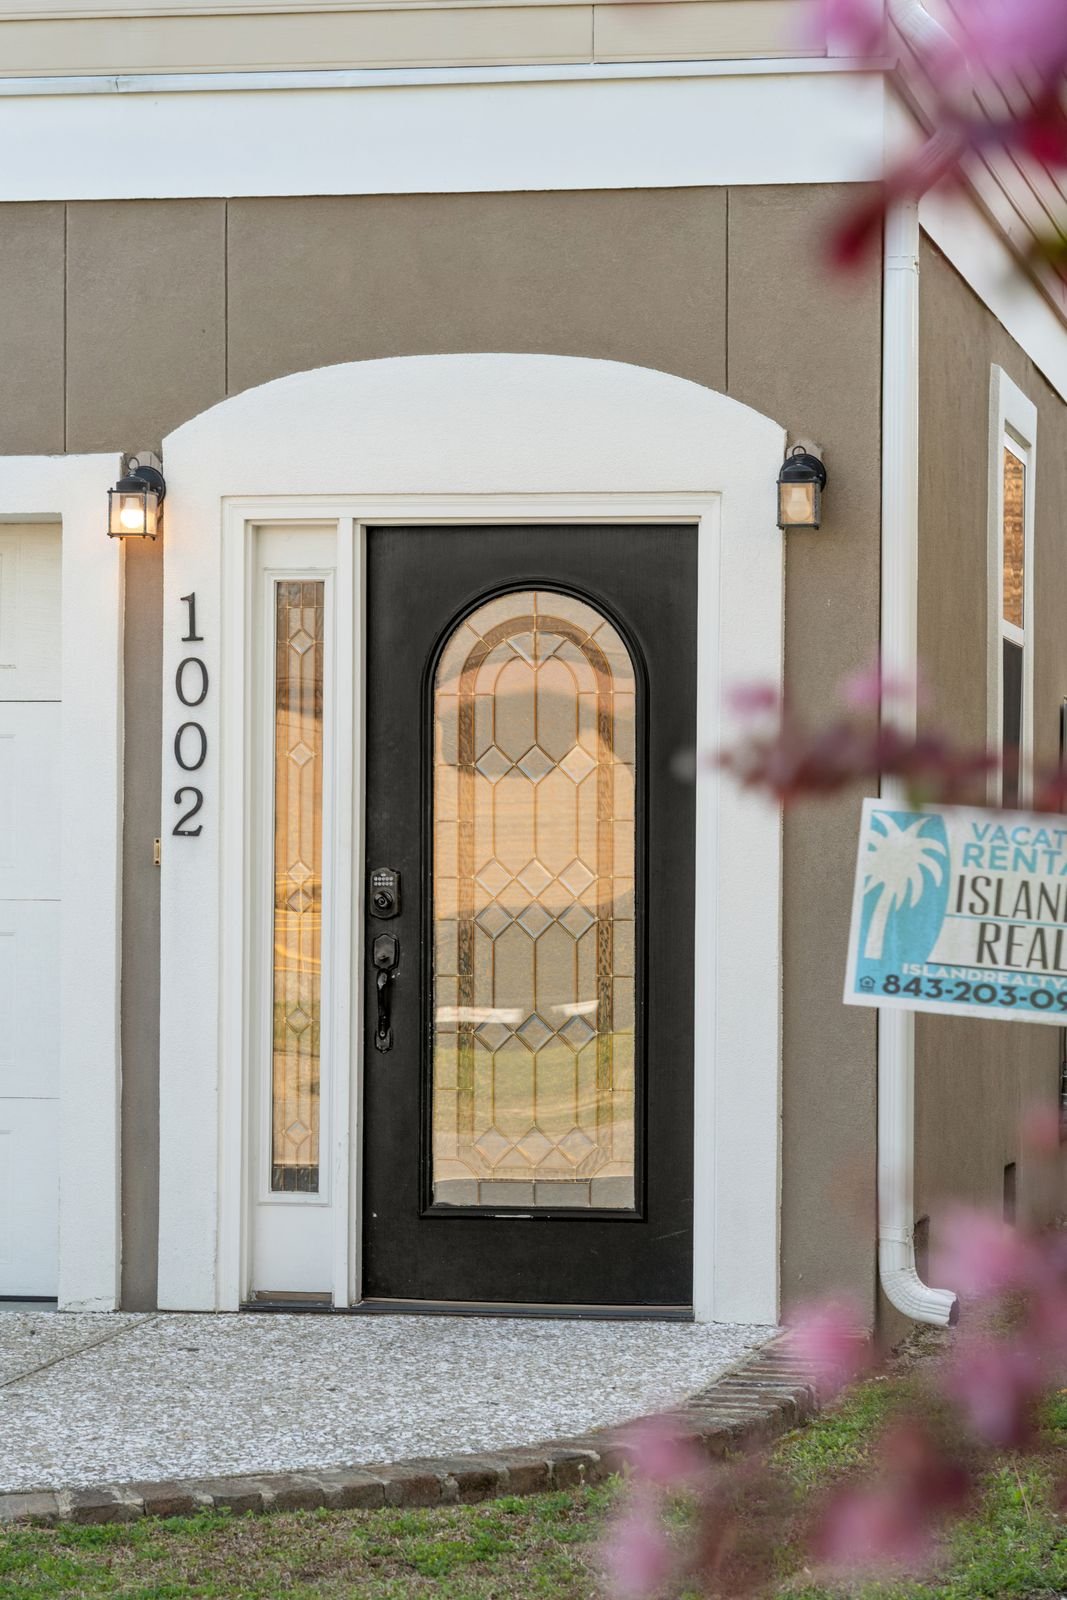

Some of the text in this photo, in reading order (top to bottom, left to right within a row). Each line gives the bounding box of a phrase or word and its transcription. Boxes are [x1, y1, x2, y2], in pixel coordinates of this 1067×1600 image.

[172, 591, 209, 837] 1002
[956, 875, 1067, 922] ISLAN
[976, 922, 1067, 972] REAL
